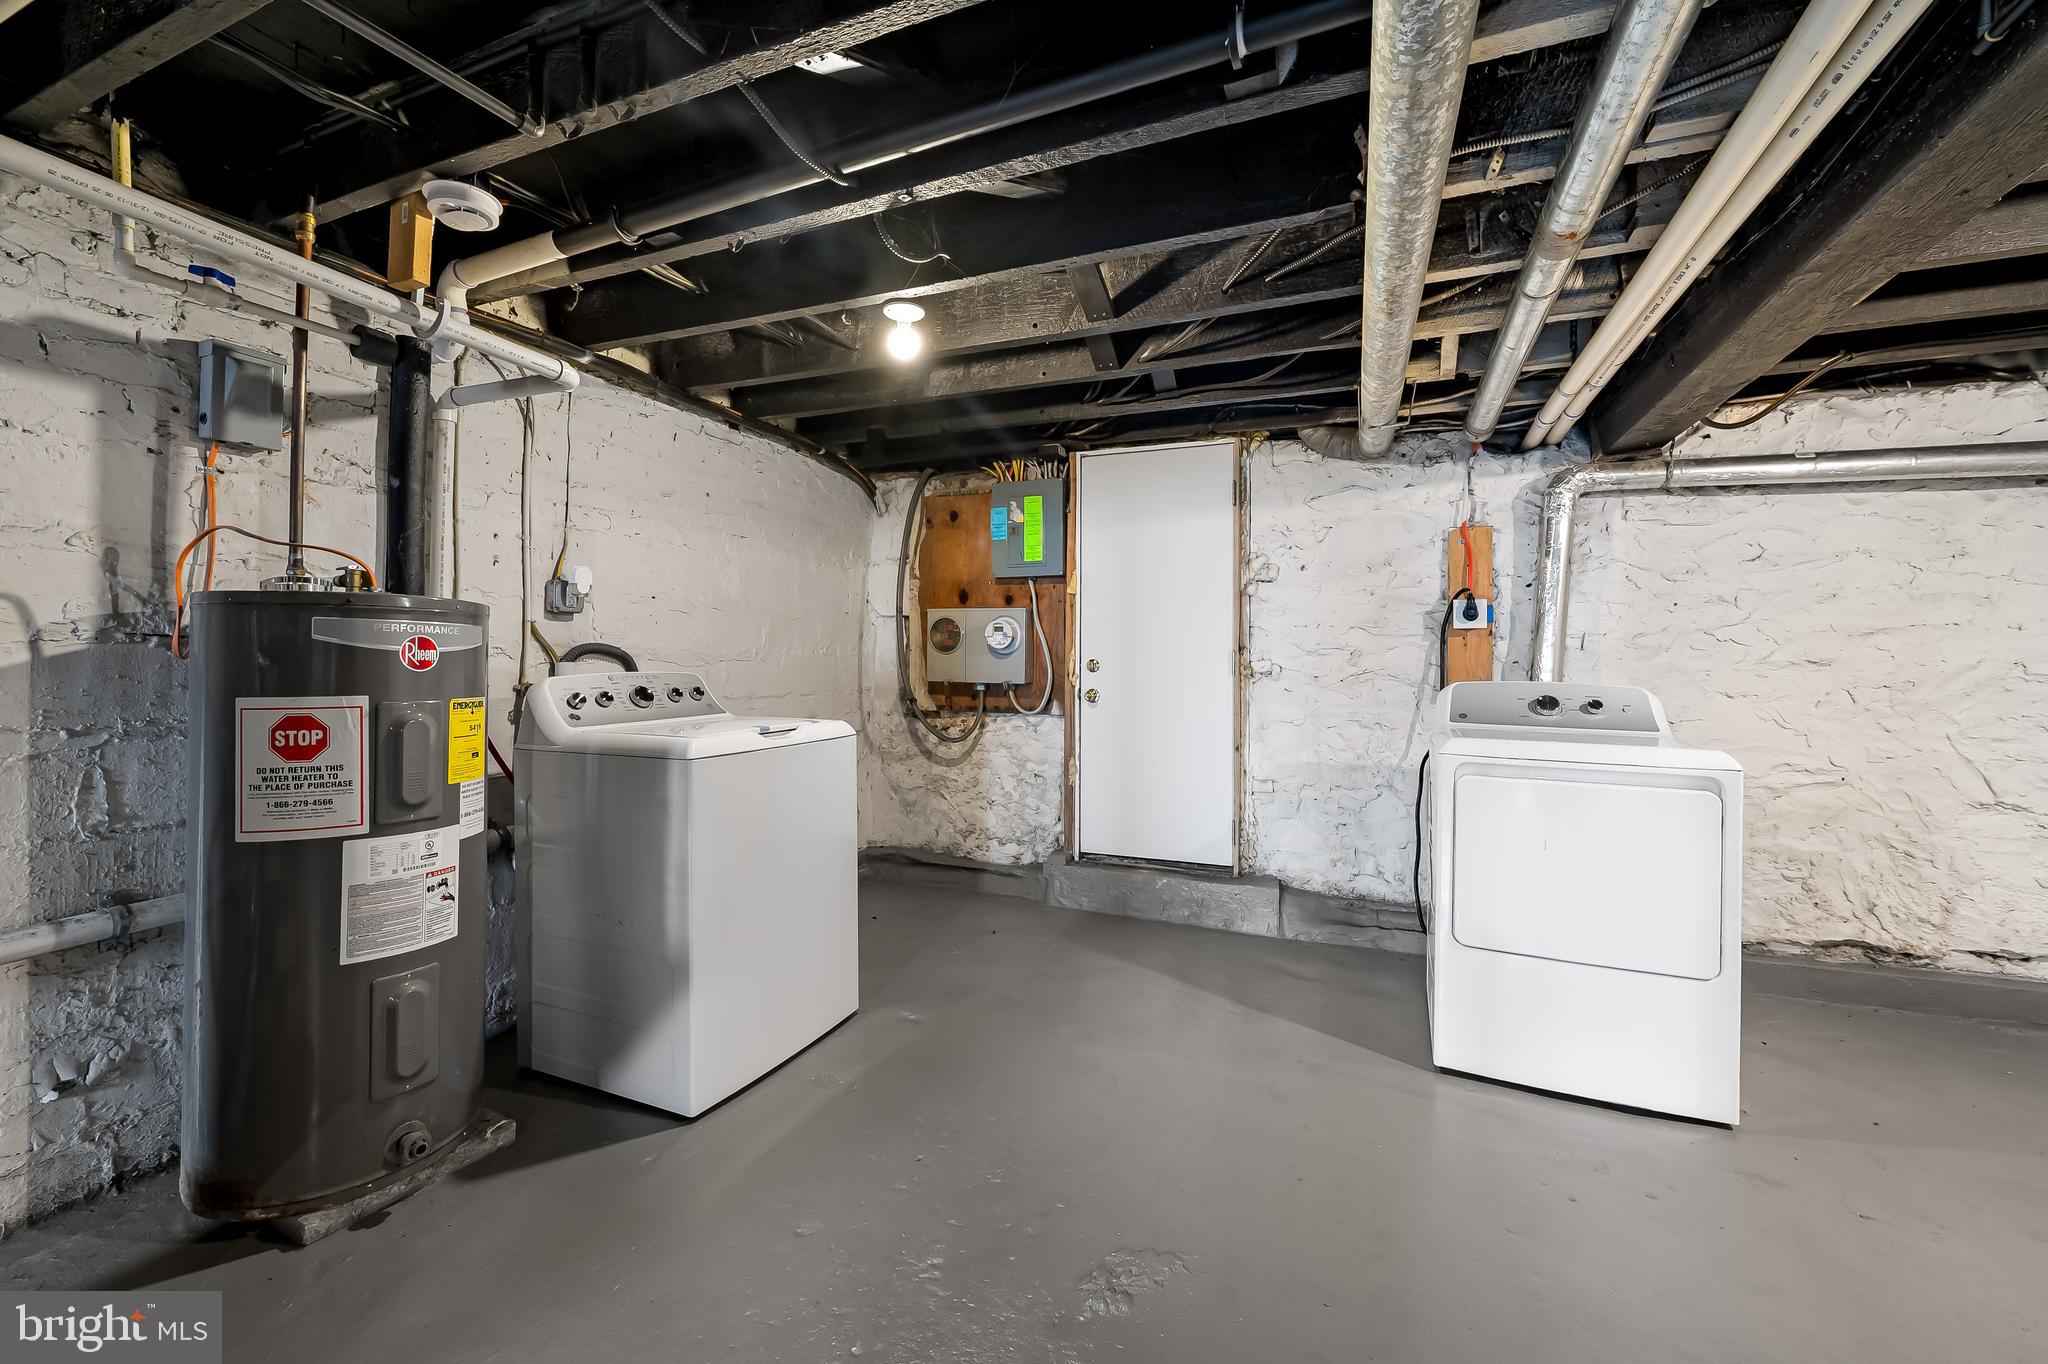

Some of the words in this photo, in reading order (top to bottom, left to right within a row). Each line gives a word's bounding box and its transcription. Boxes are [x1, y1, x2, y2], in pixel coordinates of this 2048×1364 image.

[211, 233, 234, 246] FOR
[216, 230, 271, 255] PRESSURE
[254, 250, 273, 261] NOT
[374, 624, 460, 634] PERFORMANCE
[404, 636, 436, 665] Rheem
[274, 729, 324, 747] STOP
[256, 767, 267, 775] DO
[288, 765, 322, 774] RETURN
[325, 764, 344, 772] THIS
[261, 775, 289, 783] WATER
[291, 774, 325, 782] HEATER
[248, 784, 262, 792] THE
[265, 783, 291, 791] PLACE
[294, 782, 305, 791] OF
[307, 780, 353, 789] PURCHASE
[266, 798, 334, 809] 1-866-279-4566
